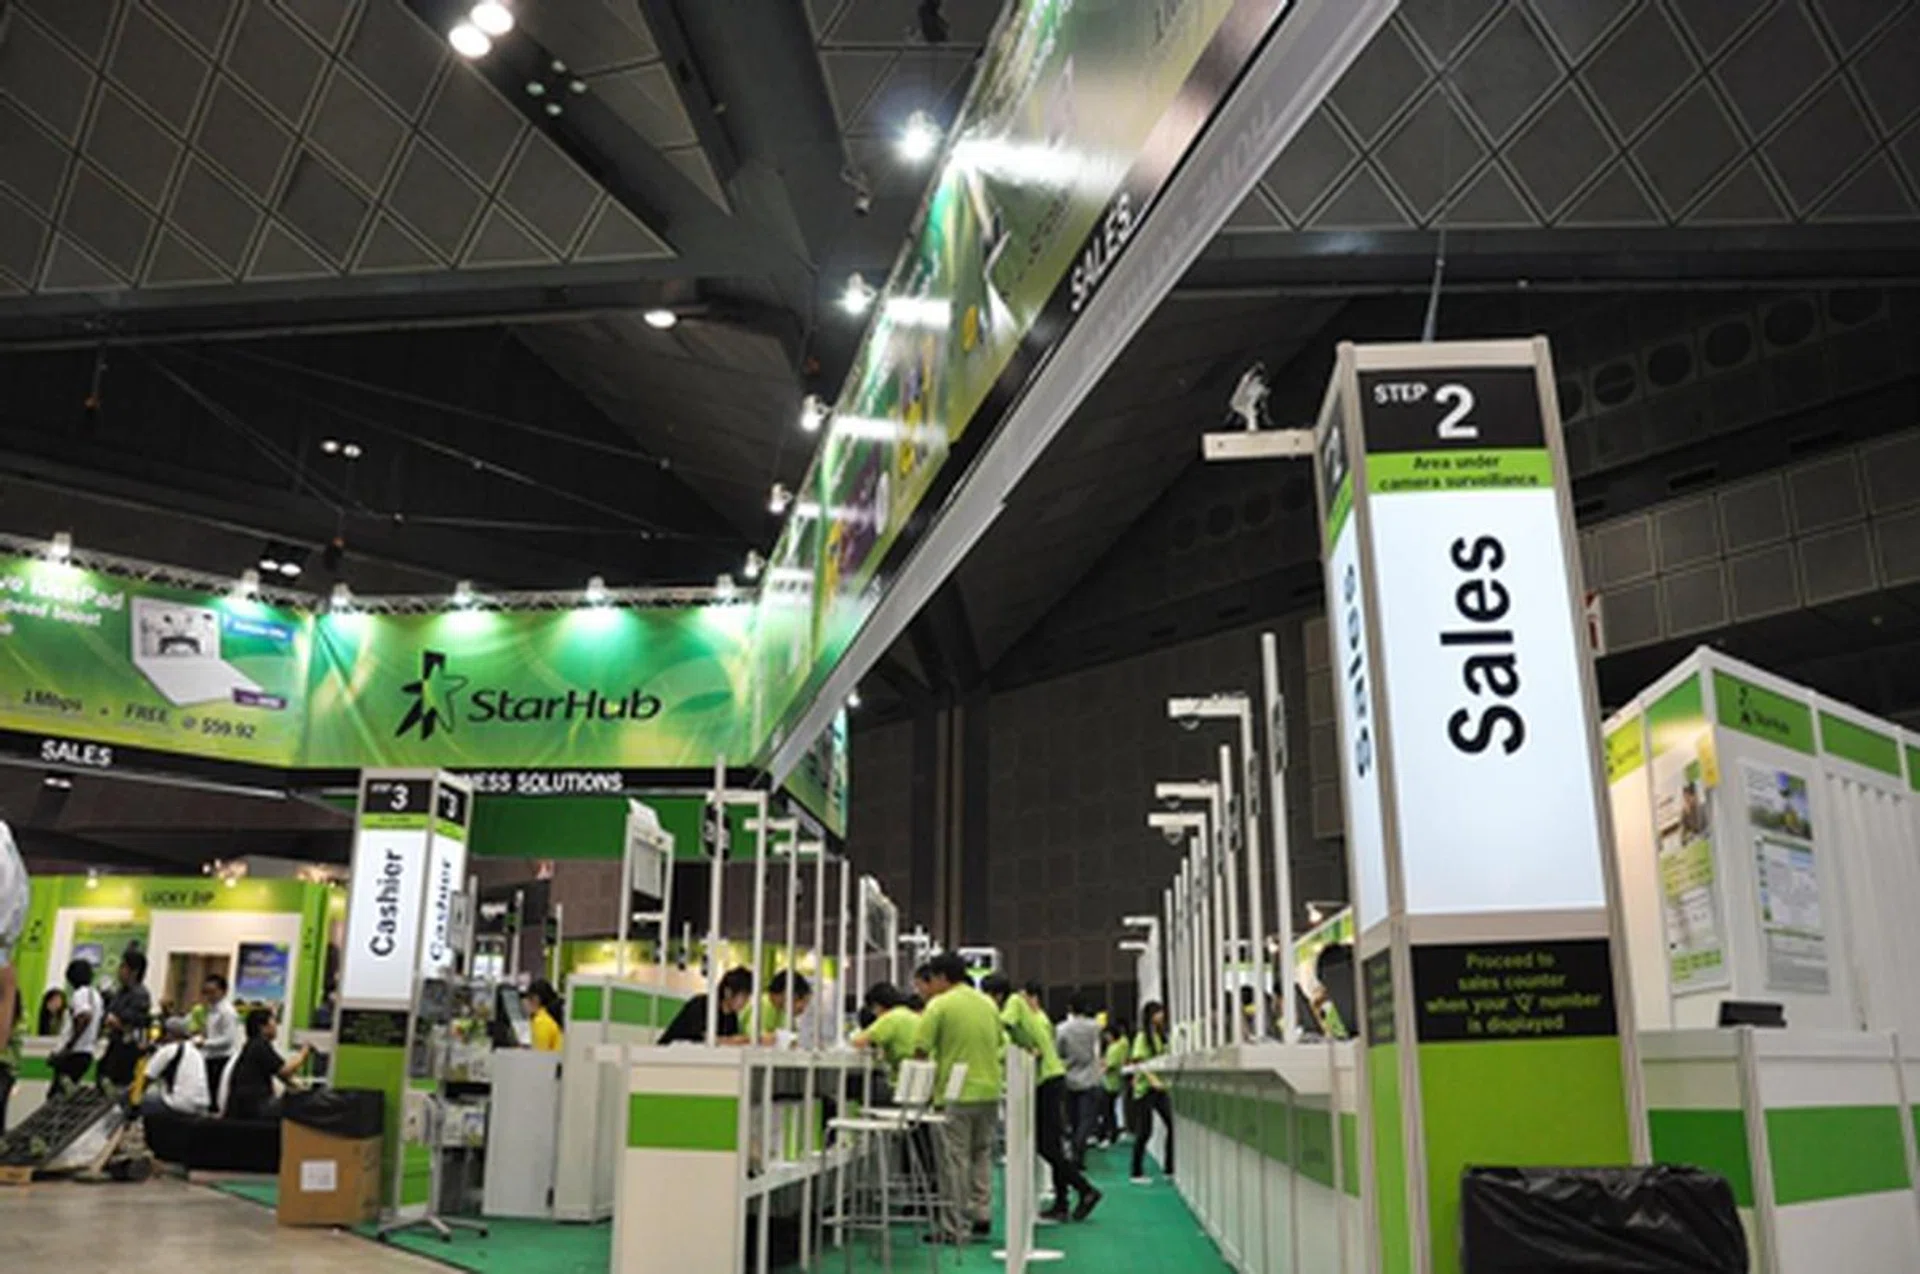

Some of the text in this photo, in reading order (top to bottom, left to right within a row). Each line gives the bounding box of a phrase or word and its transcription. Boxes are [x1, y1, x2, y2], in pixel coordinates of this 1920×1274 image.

[1071, 192, 1132, 312] SALES
[1374, 382, 1479, 440] STEP 2
[1413, 453, 1499, 470] Area under
[1379, 476, 1441, 491] camera
[1438, 534, 1526, 756] Sales
[124, 703, 168, 723] FREE
[466, 688, 662, 723] StarHub
[41, 740, 114, 768] SALES
[516, 771, 623, 794] SOLUTIONS
[390, 784, 409, 811] 3
[369, 847, 404, 957] Cashier
[1466, 952, 1533, 969] Proceed
[1457, 973, 1566, 991] sales counter
[1426, 996, 1469, 1014] when
[1540, 992, 1601, 1009] number
[1487, 1014, 1565, 1033] displayed
